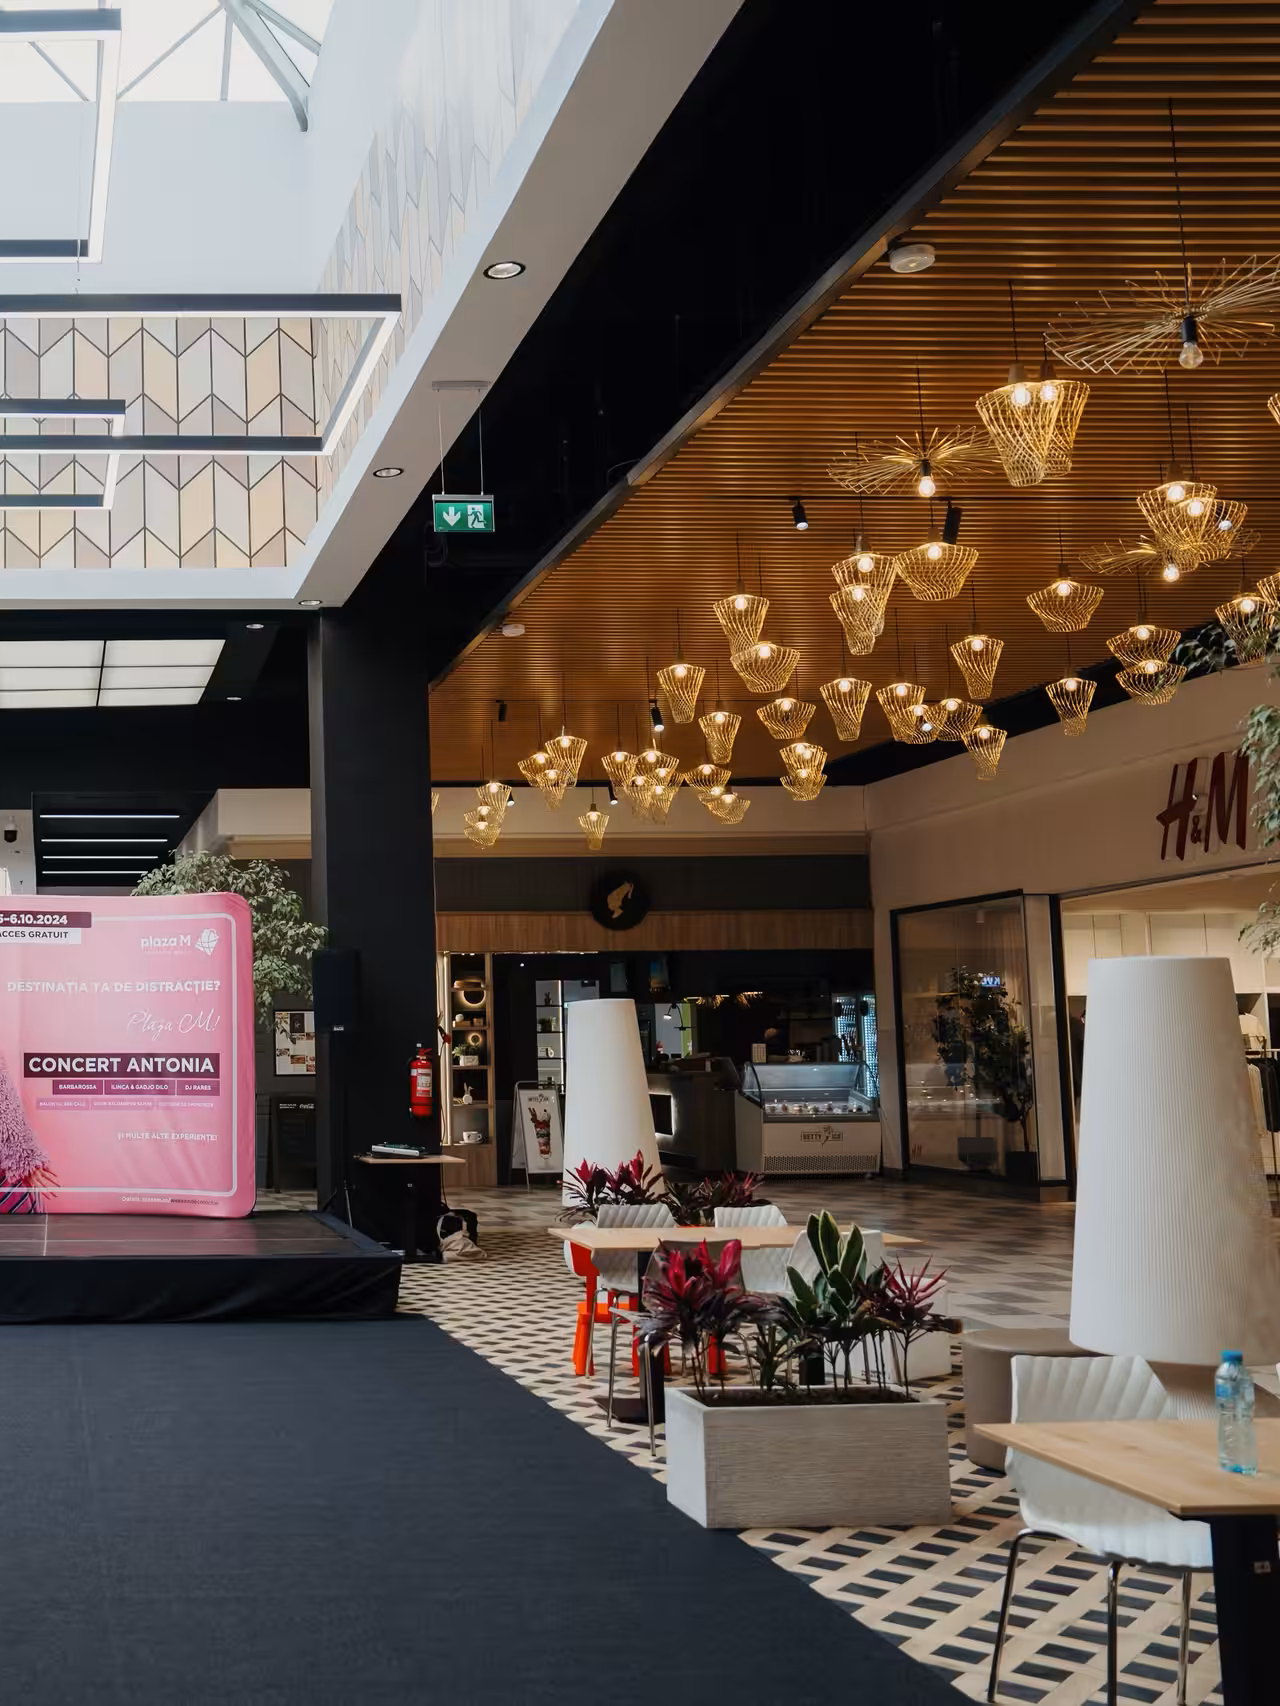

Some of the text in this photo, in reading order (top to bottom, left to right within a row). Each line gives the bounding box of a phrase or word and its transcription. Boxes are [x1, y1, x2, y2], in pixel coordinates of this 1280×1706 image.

[1156, 746, 1250, 861] H&M
[28, 931, 69, 939] GRATUIT
[140, 934, 191, 951] plaza M
[93, 982, 111, 993] TA
[114, 982, 132, 993] DE
[28, 1057, 215, 1073] CONCERT ANTONIA
